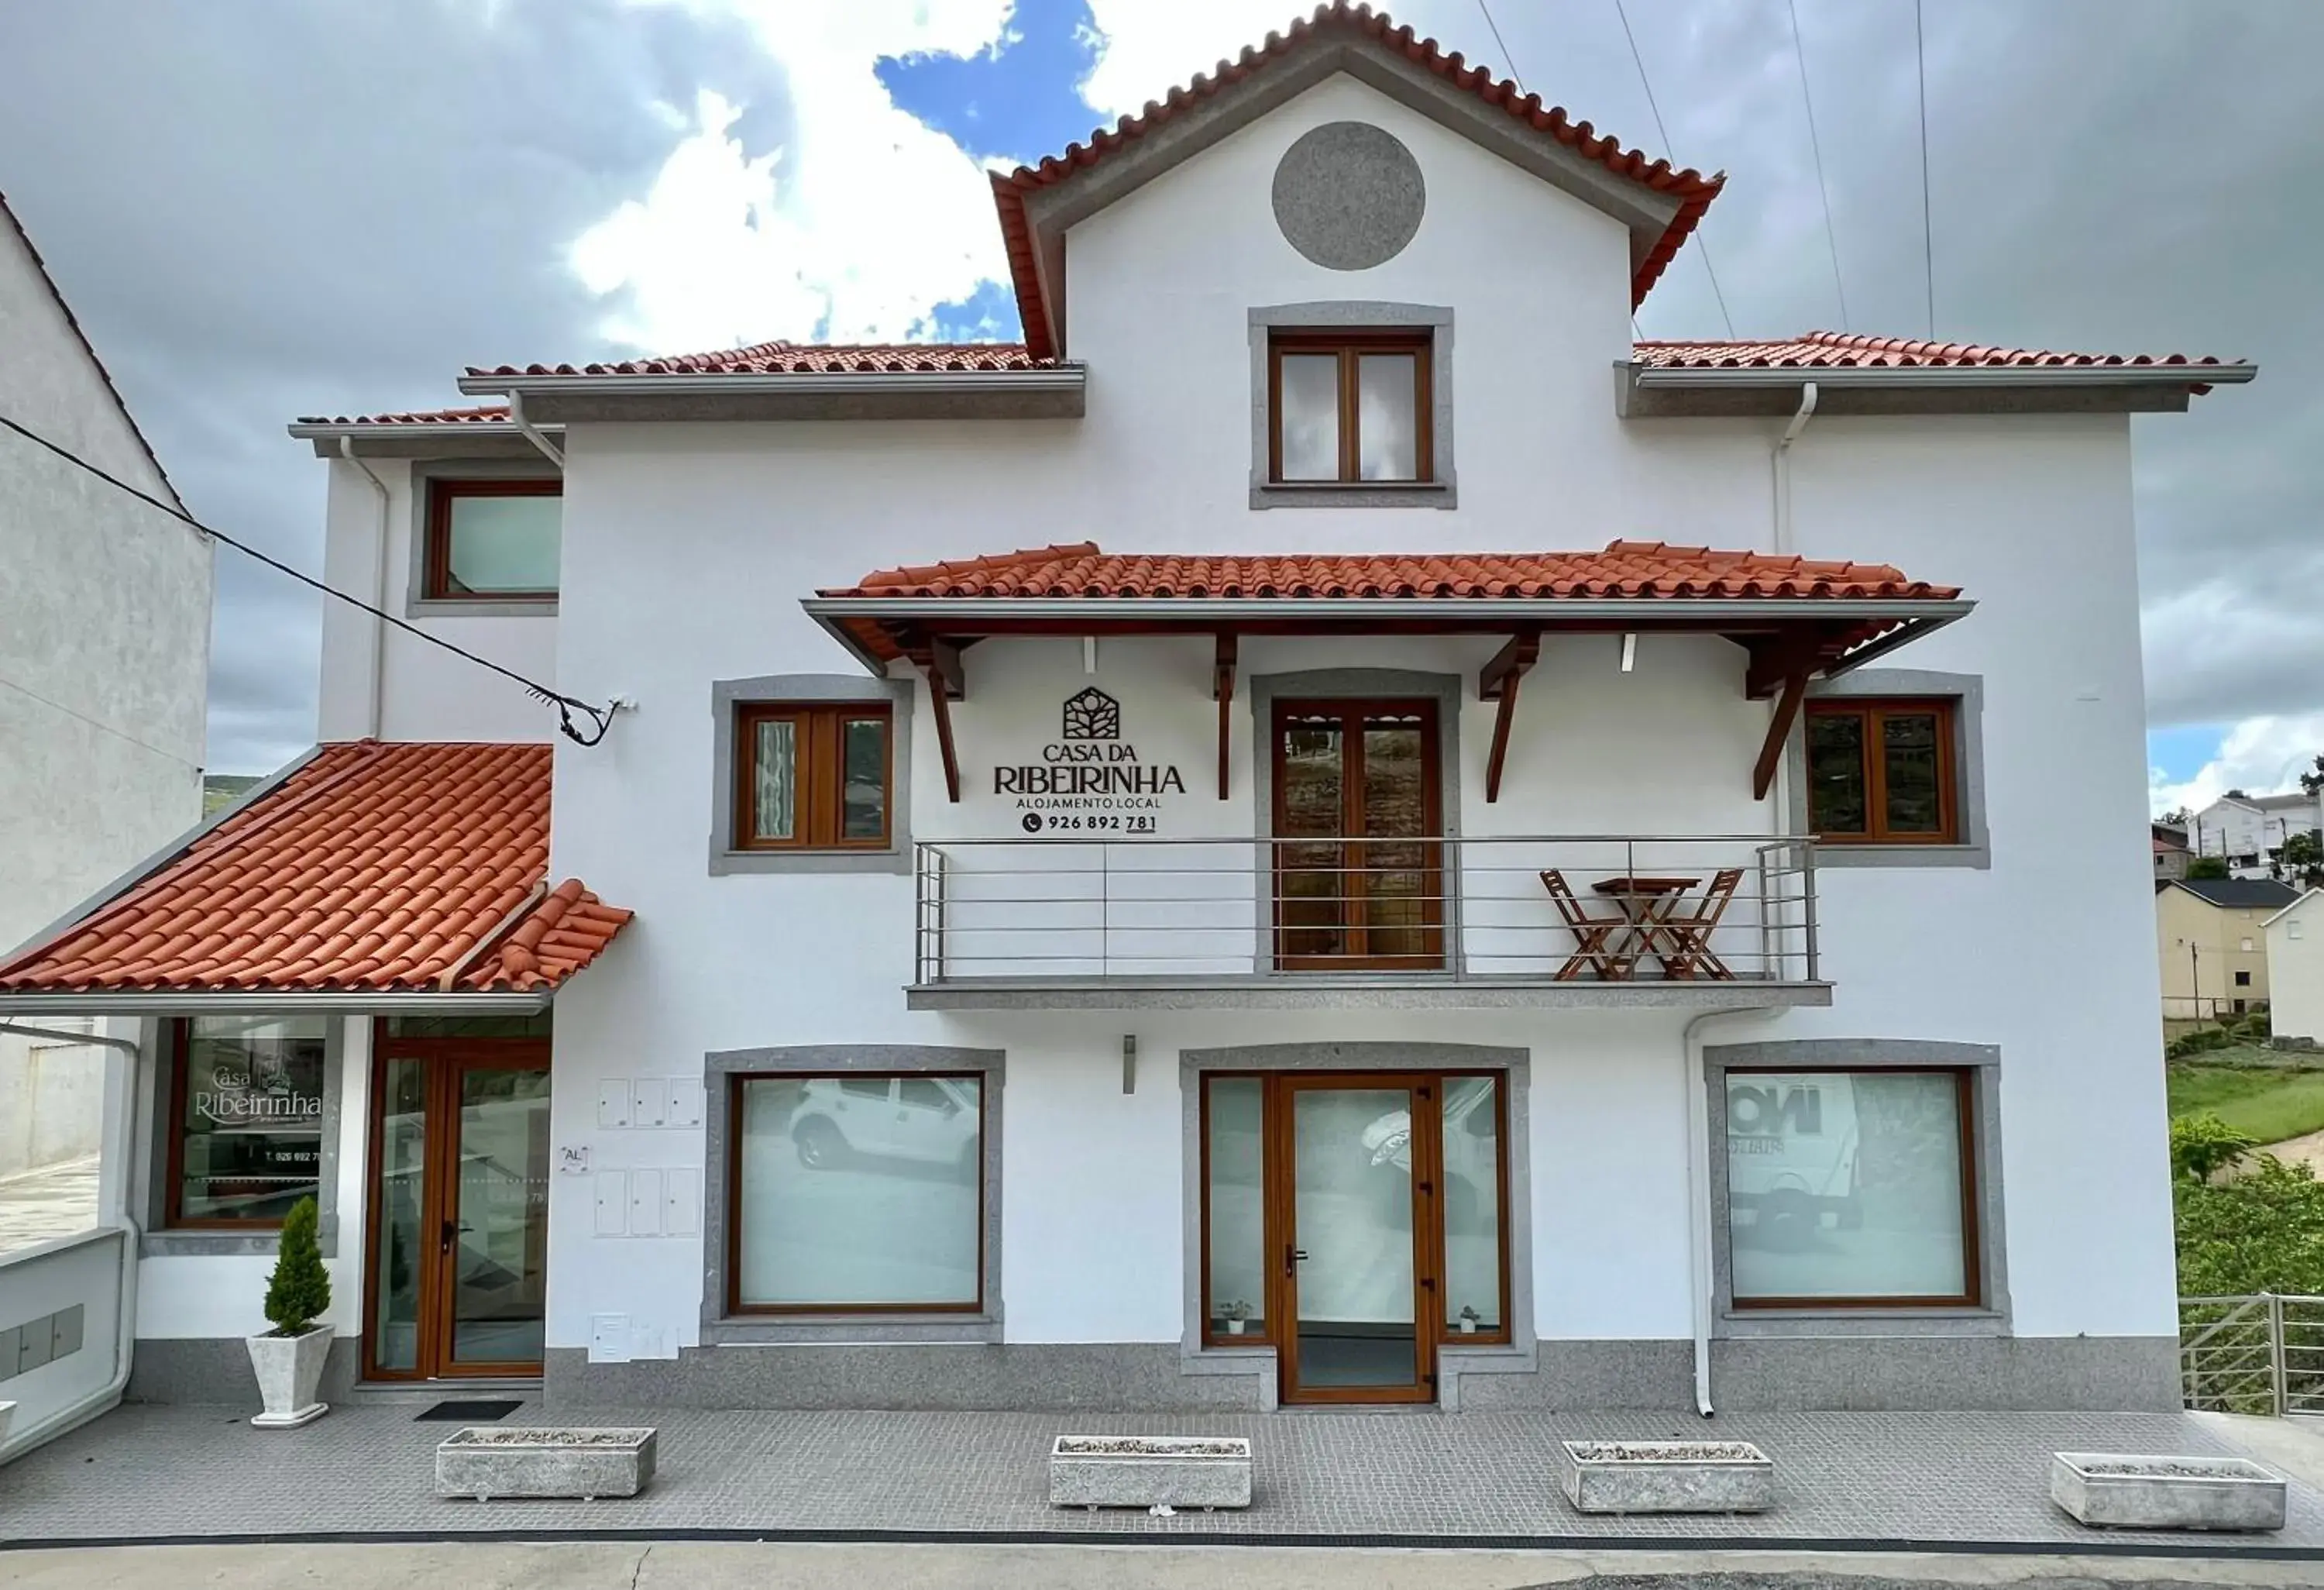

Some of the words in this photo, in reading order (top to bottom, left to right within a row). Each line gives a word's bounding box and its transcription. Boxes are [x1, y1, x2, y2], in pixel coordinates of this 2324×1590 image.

[1043, 744, 1103, 762] CASA
[1109, 744, 1137, 762] DA
[994, 766, 1186, 794] RIBEIRINHA
[1016, 798, 1113, 809] ALOJAMENTO
[1116, 798, 1161, 809] LOCAL
[1048, 816, 1081, 829] 926
[1087, 816, 1119, 829] 892
[1126, 816, 1156, 829] 781
[211, 1066, 251, 1090] Casa
[195, 1091, 322, 1124] Ribeirinha
